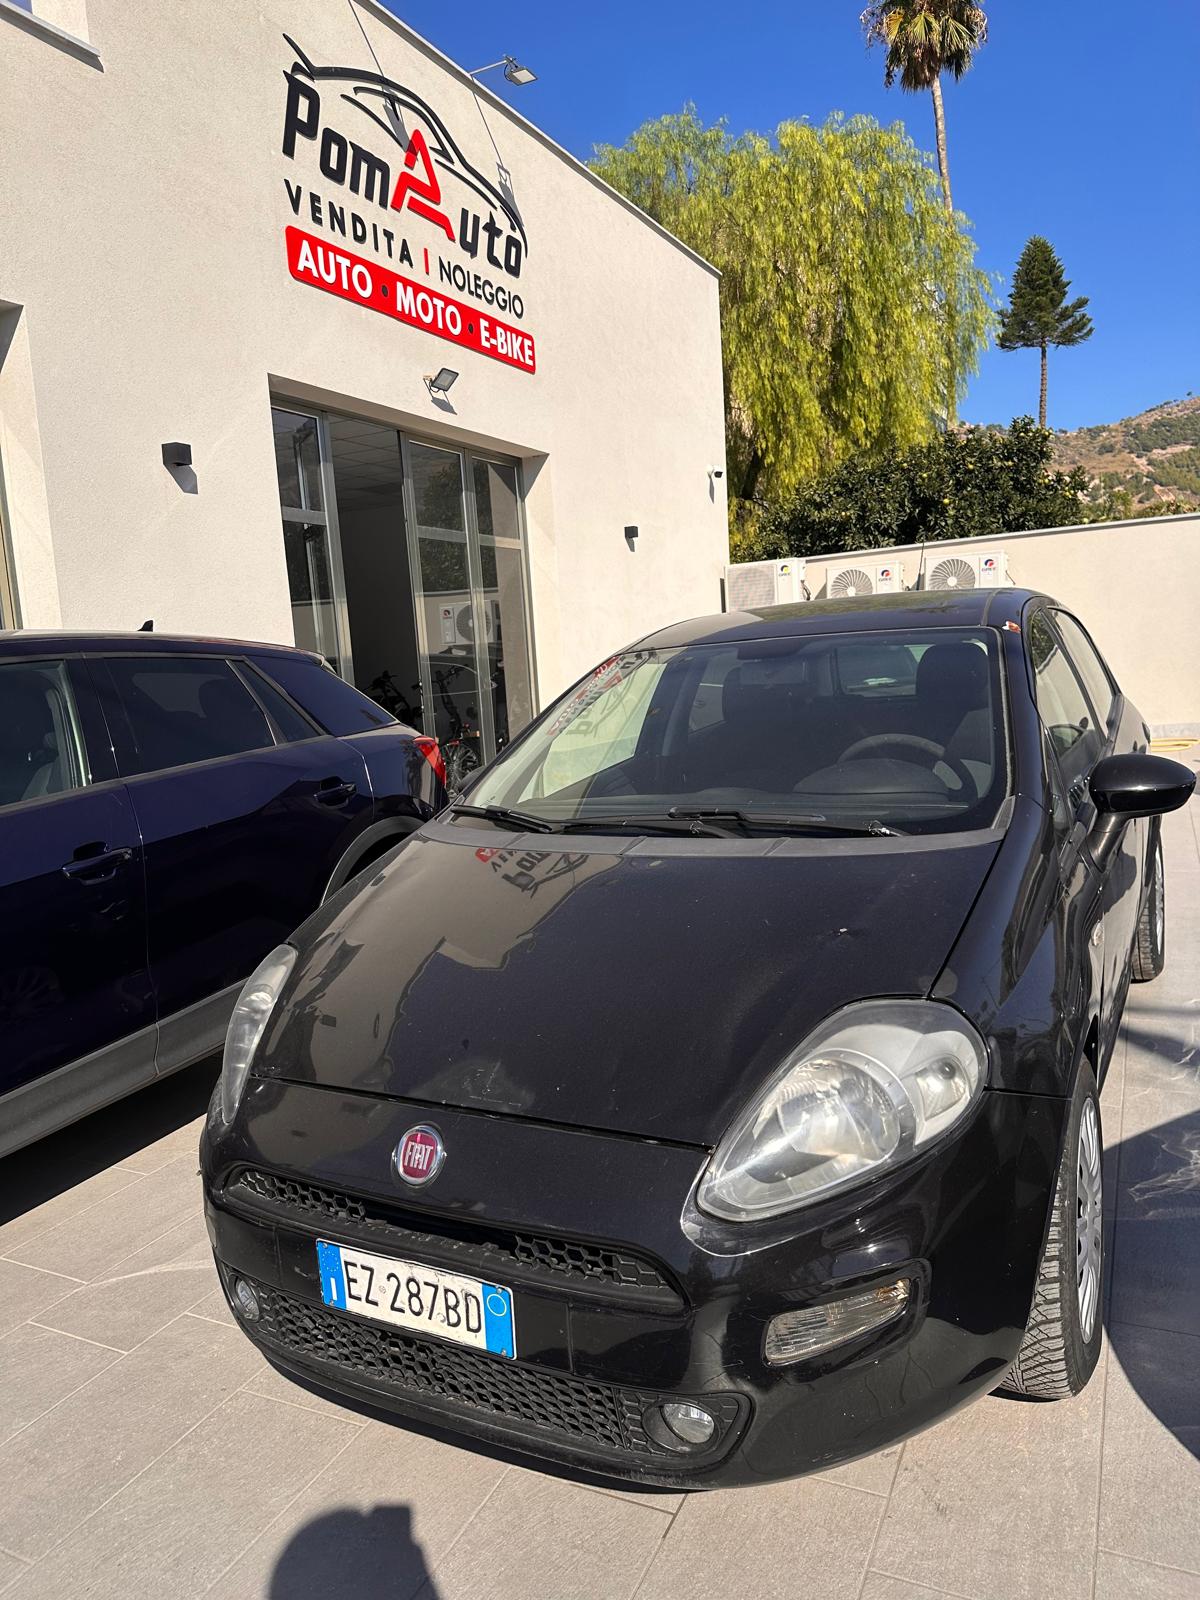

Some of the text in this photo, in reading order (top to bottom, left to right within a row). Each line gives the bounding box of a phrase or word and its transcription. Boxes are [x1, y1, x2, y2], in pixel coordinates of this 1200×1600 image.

[284, 179, 523, 319] VENDITA NOLEGGIO
[297, 239, 534, 366] AUTO MOTO E-BIKE
[404, 1141, 433, 1170] FIAT
